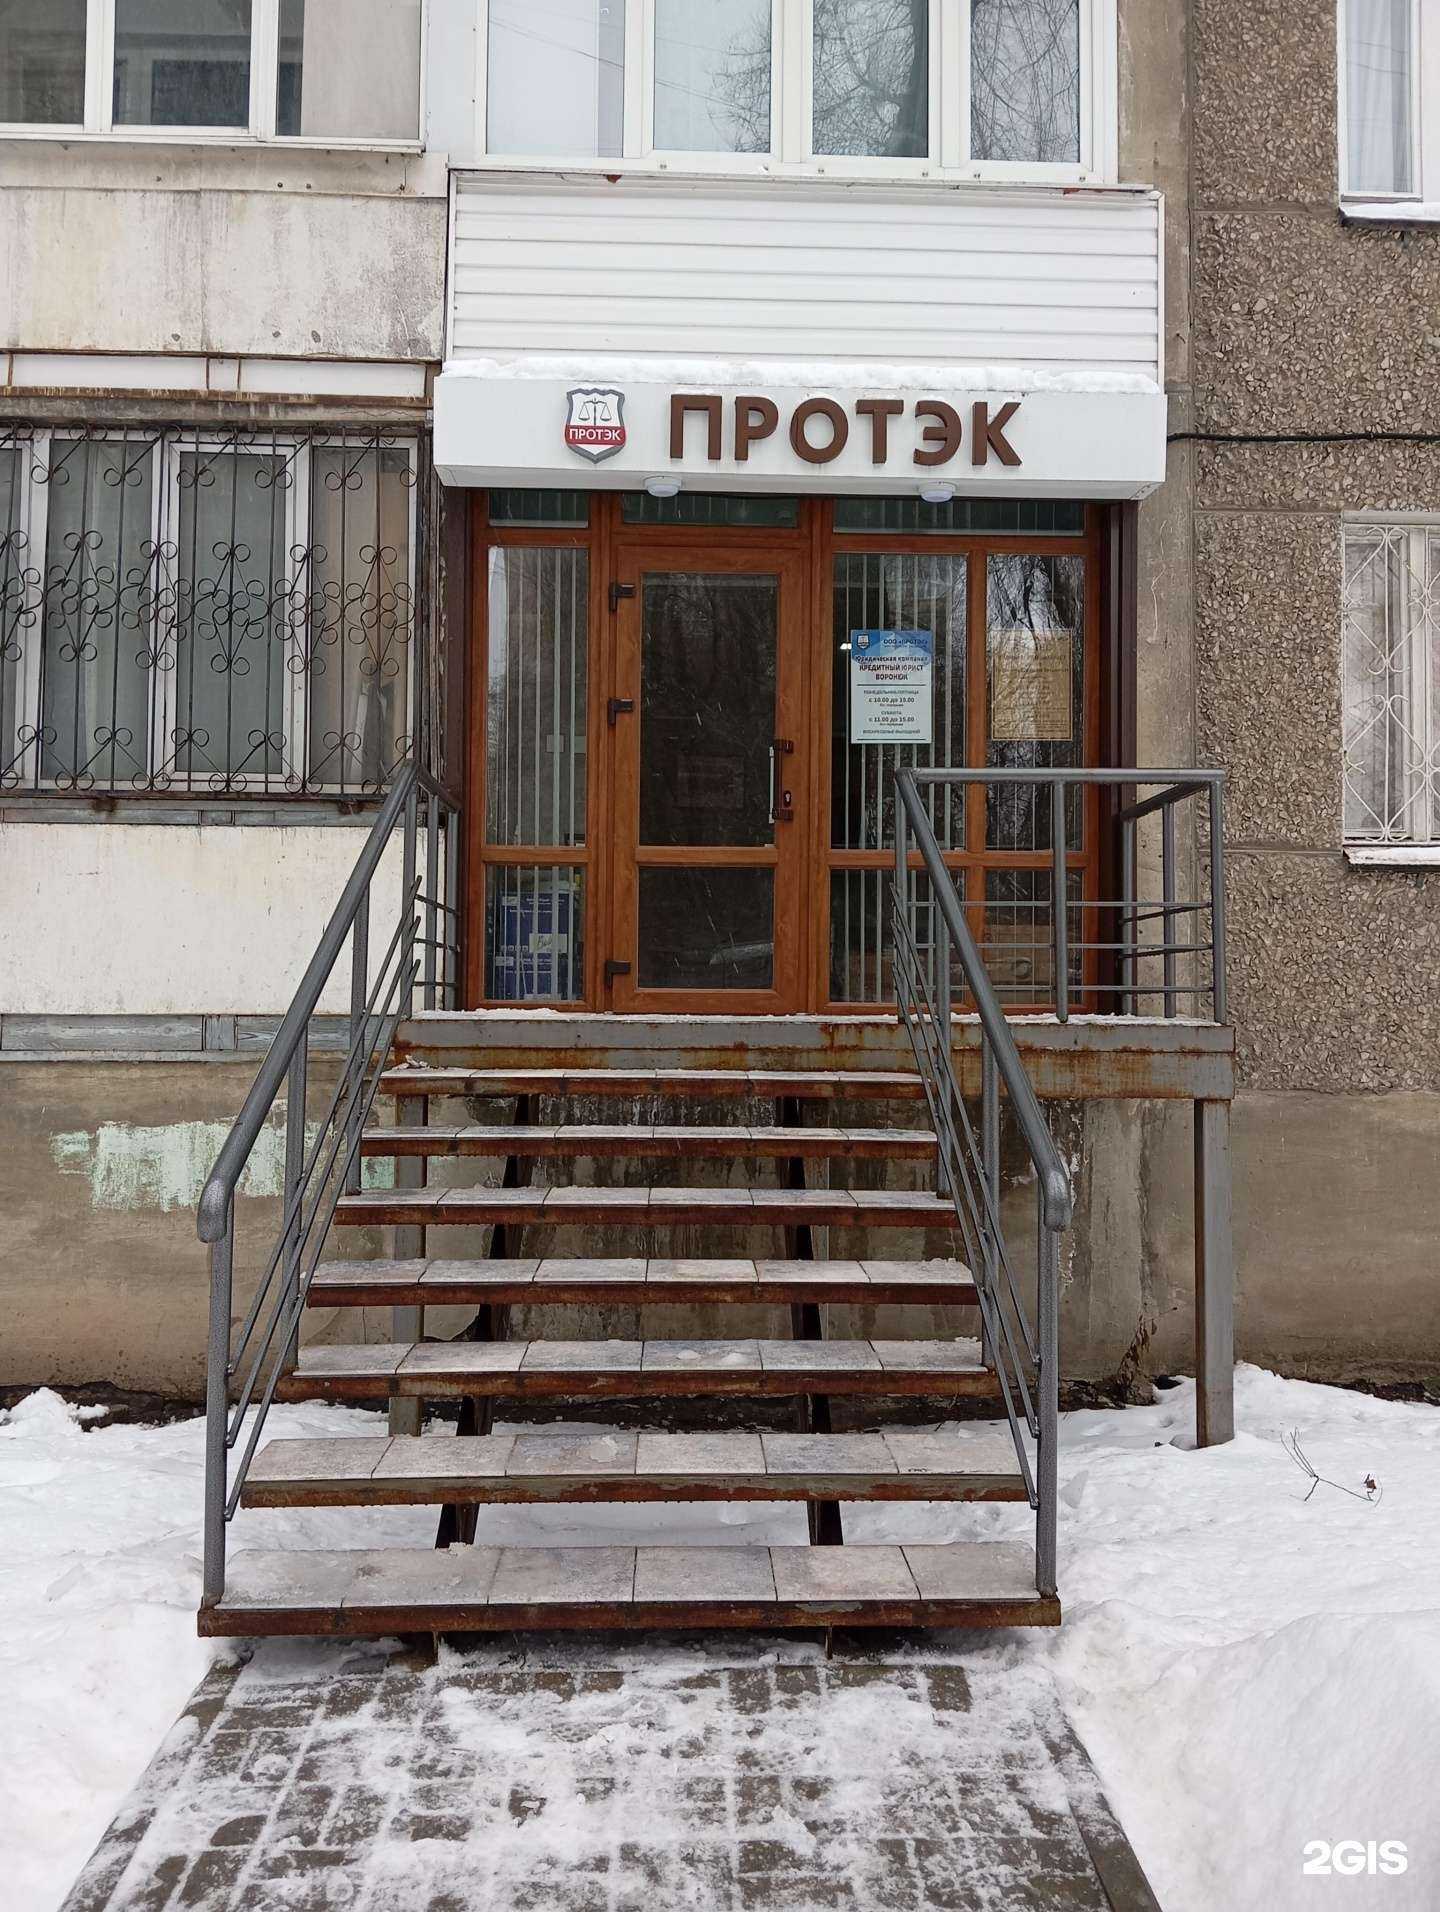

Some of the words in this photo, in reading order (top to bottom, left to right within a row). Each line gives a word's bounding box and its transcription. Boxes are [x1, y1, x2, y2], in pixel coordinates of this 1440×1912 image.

[569, 427, 621, 441] ПРОТЭК
[669, 394, 1022, 466] ПРОТЭК
[859, 664, 900, 672] КРЕДИТНЫЙ
